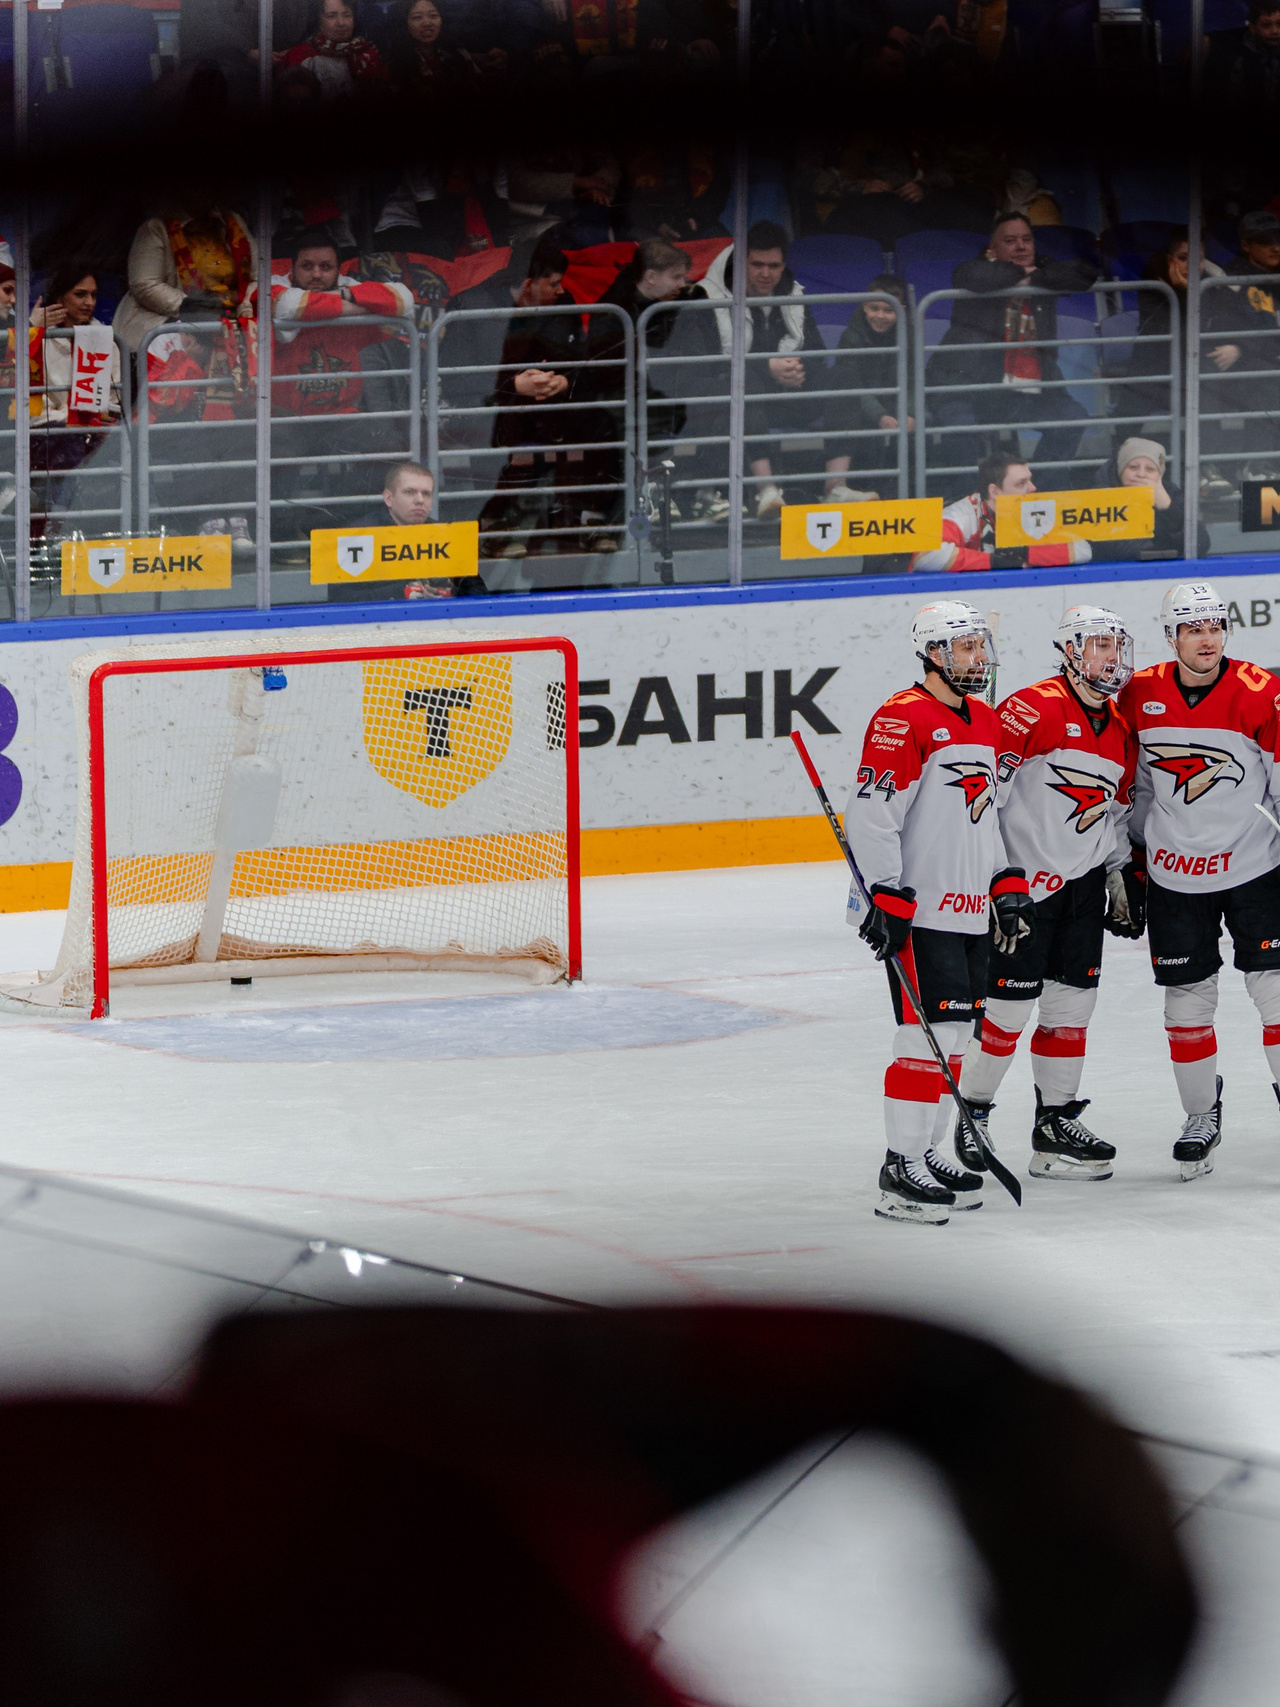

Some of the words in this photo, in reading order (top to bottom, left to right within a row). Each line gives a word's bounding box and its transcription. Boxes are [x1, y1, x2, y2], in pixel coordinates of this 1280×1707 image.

[1061, 505, 1128, 525] БАНК
[848, 518, 915, 537] БАНК
[380, 542, 450, 561] БАНК
[132, 554, 203, 574] БАНК
[1190, 586, 1208, 595] 13
[546, 667, 842, 750] БАНК
[857, 766, 896, 803] 24
[1153, 848, 1233, 876] FONBET
